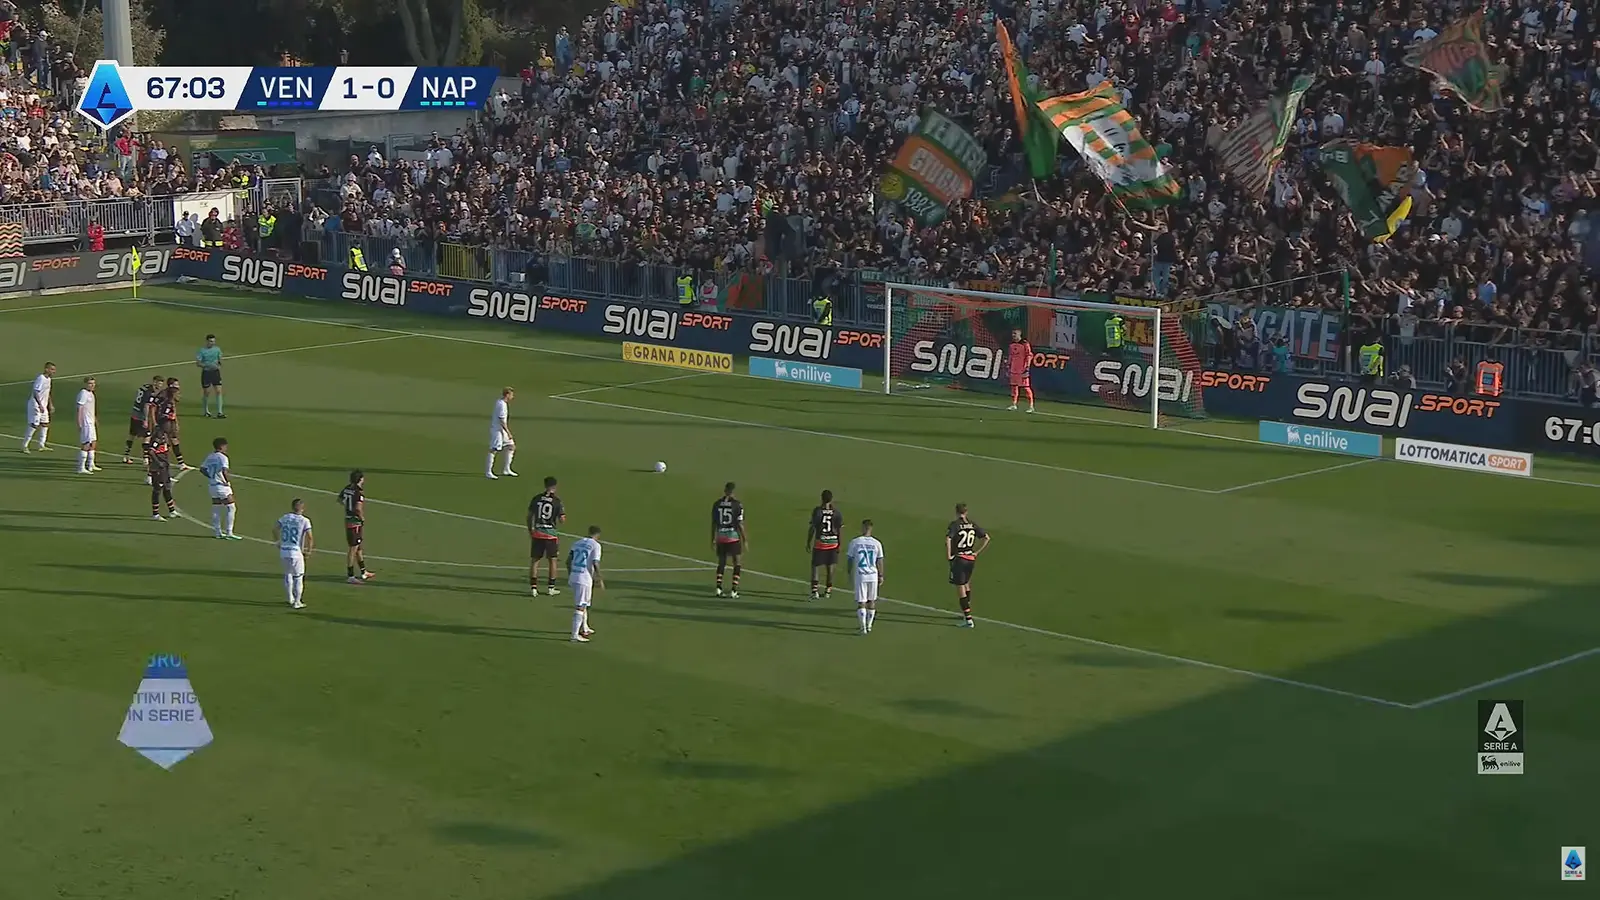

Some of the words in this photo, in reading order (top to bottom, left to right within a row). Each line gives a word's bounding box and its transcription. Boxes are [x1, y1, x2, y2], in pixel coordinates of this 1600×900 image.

[633, 345, 675, 363] GRANA
[680, 351, 731, 369] PADANO
[790, 366, 832, 383] enilive
[1303, 431, 1349, 451] enilive
[1399, 443, 1486, 466] LOTTOMATICA
[537, 502, 553, 520] 19
[718, 507, 733, 525] 15
[822, 515, 832, 533] 5
[957, 530, 976, 549] 26
[858, 549, 875, 568] 21
